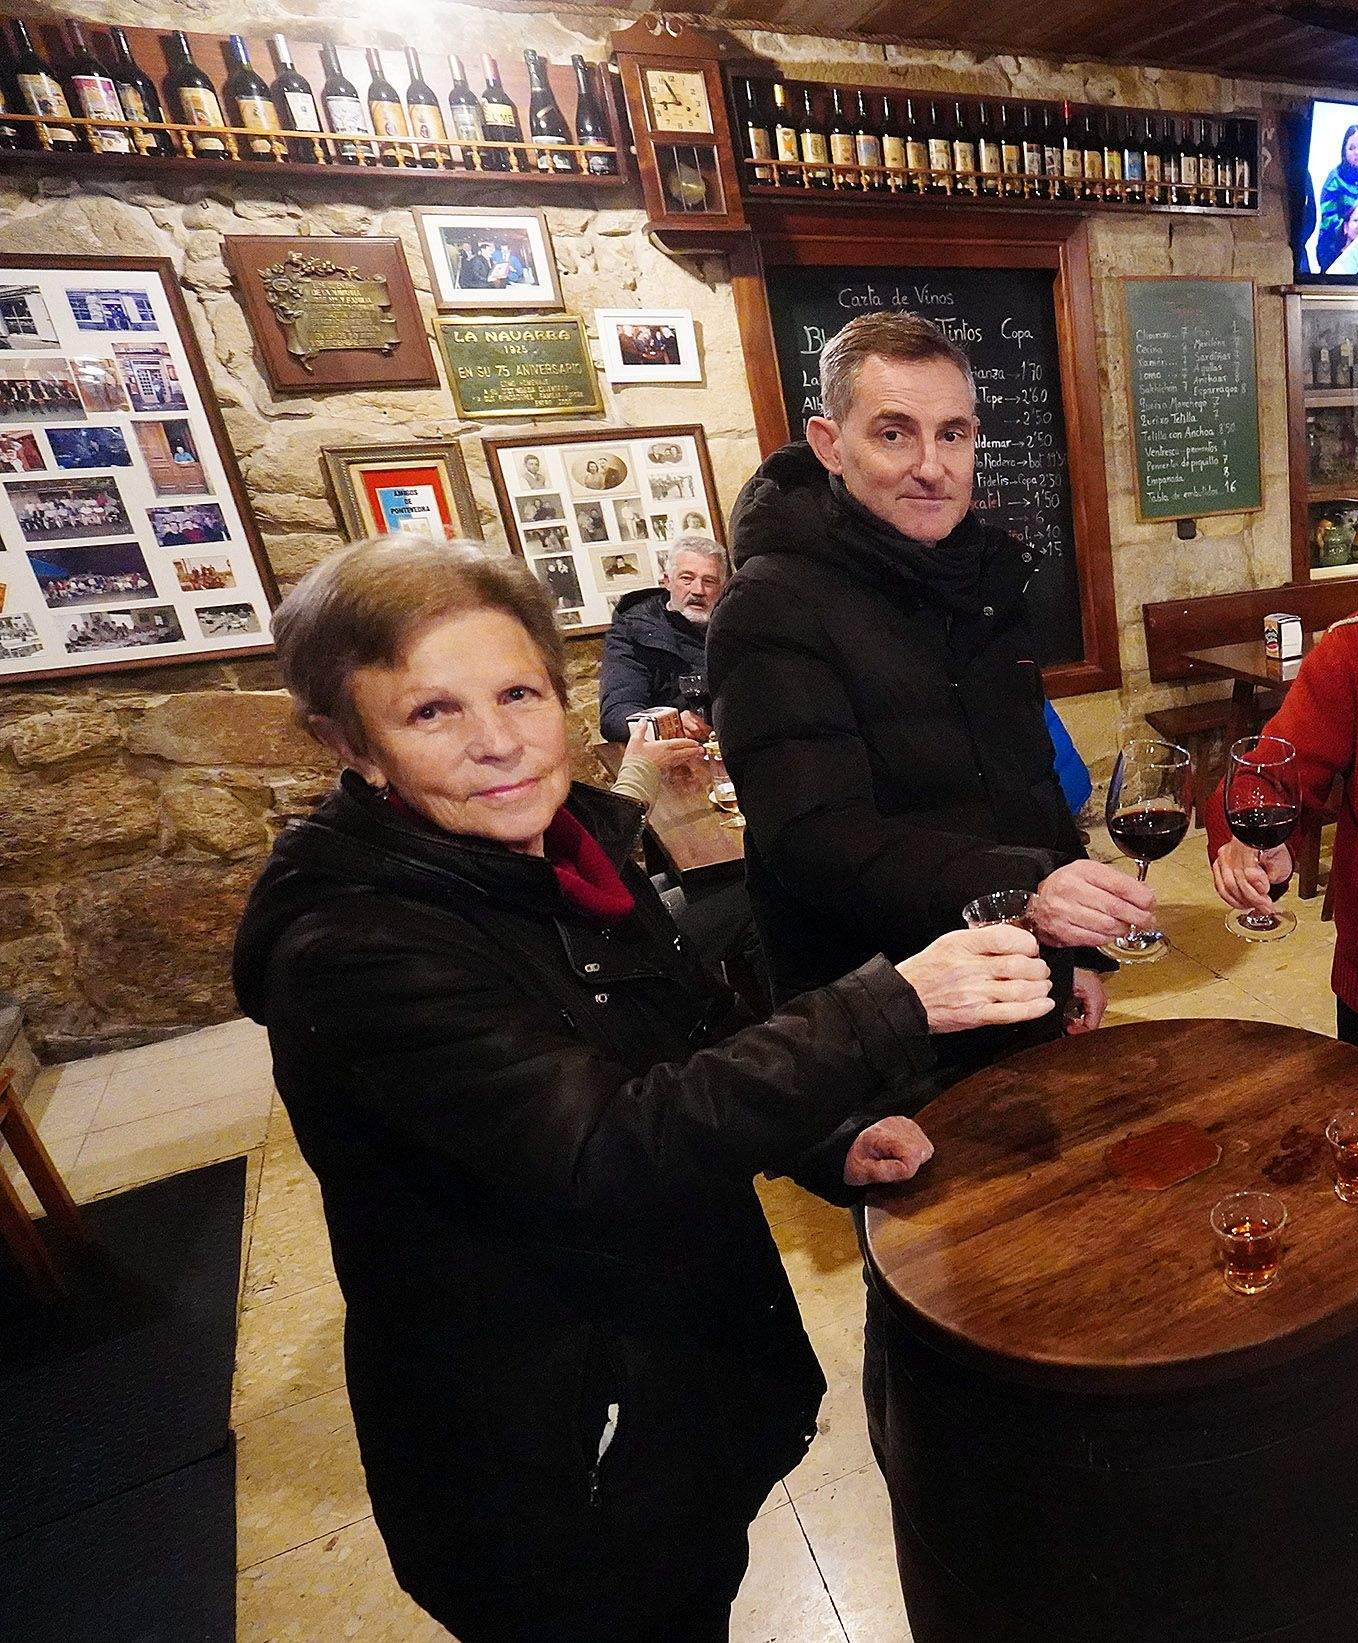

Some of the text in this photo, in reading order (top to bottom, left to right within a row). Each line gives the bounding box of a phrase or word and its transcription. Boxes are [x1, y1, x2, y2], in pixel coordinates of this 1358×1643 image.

[838, 283, 954, 308] Carta de Vinos
[454, 329, 572, 343] LA NAVARRA
[934, 317, 1034, 349] Tintos Copa
[458, 366, 473, 379] EN
[476, 366, 491, 378] SU
[495, 364, 511, 377] 75
[1021, 386, 1048, 405] 2'60
[1184, 426, 1215, 438] Anchoa
[976, 472, 1010, 488] Fidelis
[1224, 480, 1237, 493] 16
[1047, 541, 1062, 556] 15
